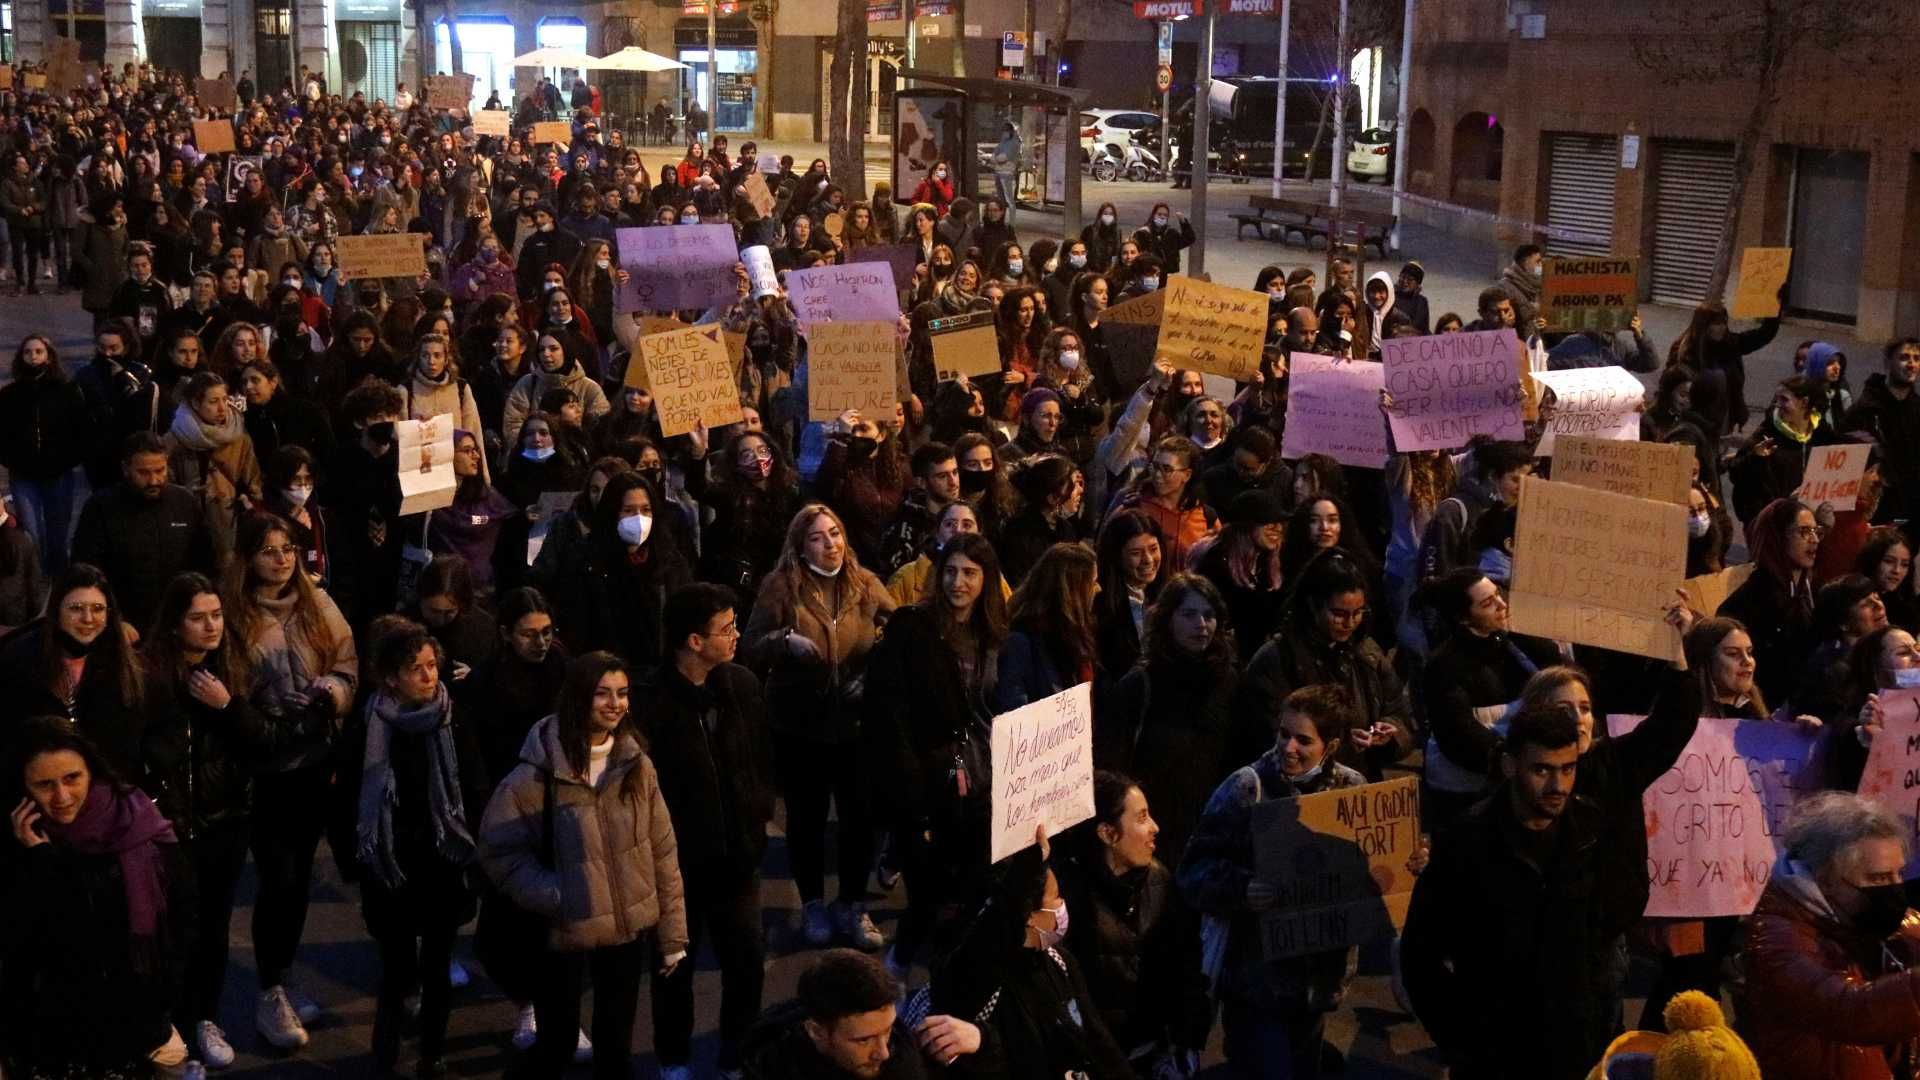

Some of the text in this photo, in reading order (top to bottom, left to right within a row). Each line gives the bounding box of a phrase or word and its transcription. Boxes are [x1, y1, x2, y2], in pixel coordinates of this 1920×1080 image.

[868, 11, 897, 21] MOTUL
[920, 4, 948, 16] MOTUL
[1144, 2, 1193, 16] MOTUL
[1160, 74, 1169, 84] 30
[1554, 261, 1632, 275] MACHISTA
[1552, 294, 1600, 307] ABONO
[645, 330, 700, 359] SOM LES
[814, 341, 849, 355] CASA
[853, 341, 871, 353] NO
[1387, 342, 1412, 368] DE
[1420, 334, 1483, 361] CAMINO
[1491, 334, 1508, 355] A
[648, 353, 686, 371] NETES
[691, 348, 709, 362] DE
[656, 370, 676, 386] LES
[1391, 366, 1441, 395] CASA
[1448, 360, 1507, 389] QUIERO
[663, 384, 735, 411] QUE NO VAU
[1392, 396, 1432, 419] SER
[1410, 414, 1482, 442] VALIENTE
[1549, 412, 1606, 434] NOSOTRAS
[1580, 459, 1599, 474] NO
[1823, 450, 1848, 471] NO
[1799, 480, 1811, 497] A
[1812, 480, 1829, 500] LA
[1535, 496, 1614, 532] MIENTRAS
[1529, 531, 1601, 560] MUJERES
[1529, 556, 1568, 598] NO
[1004, 722, 1027, 775] No
[1004, 774, 1027, 798] ser
[1659, 753, 1764, 795] SOMOS
[1004, 803, 1025, 831] los
[1673, 802, 1785, 845] GRITO DE
[1355, 822, 1401, 857] FORT
[1647, 853, 1770, 888] QUE YA NO
